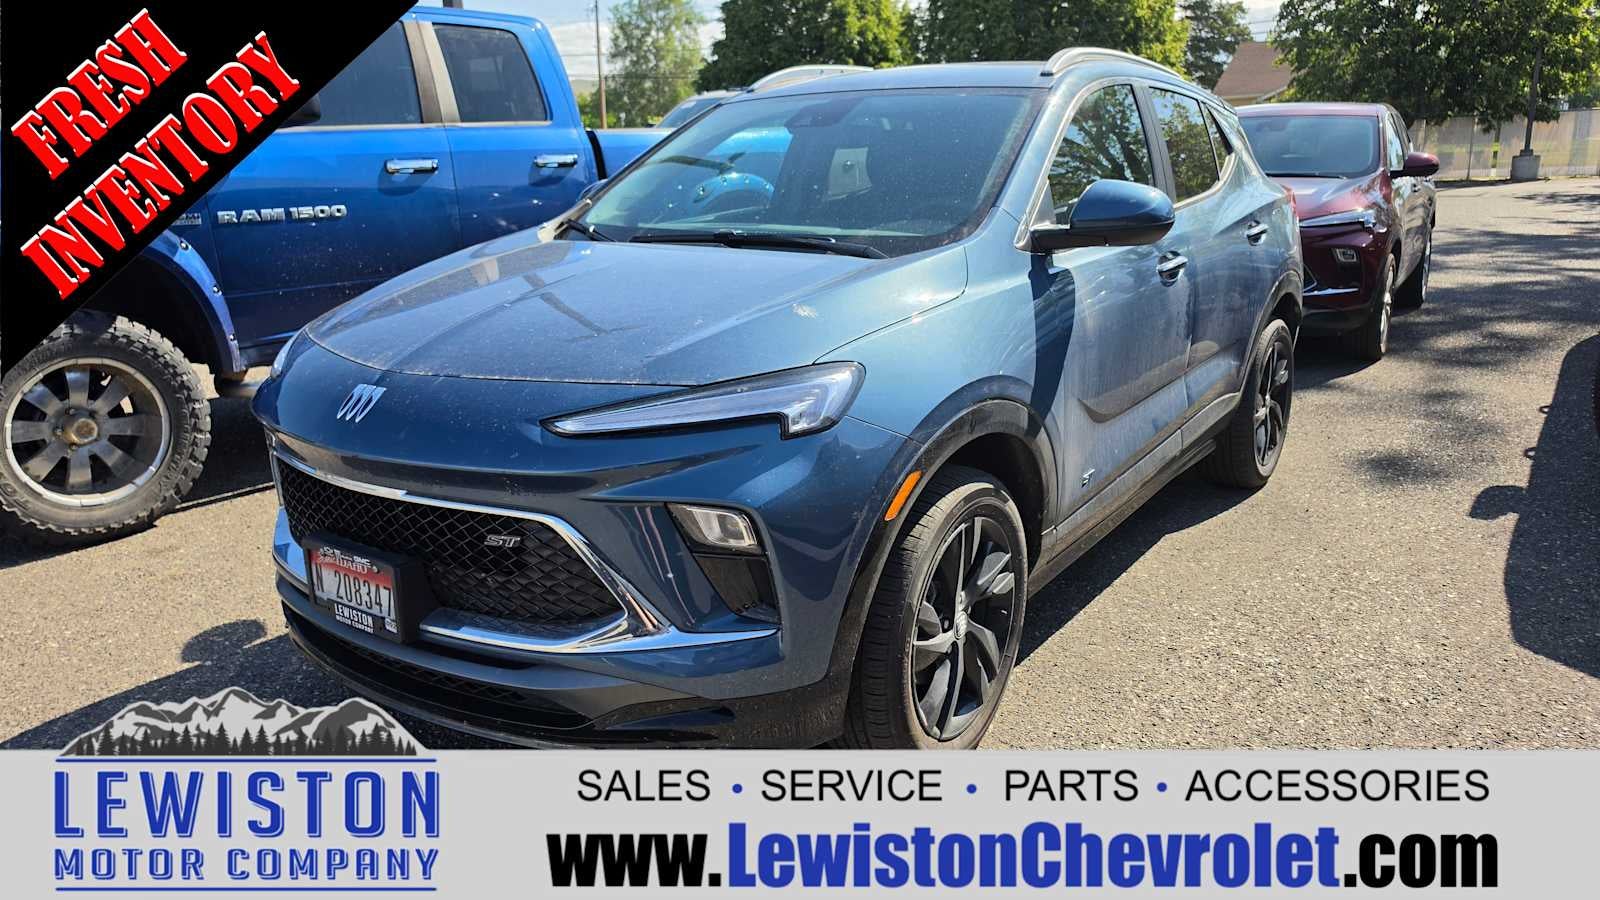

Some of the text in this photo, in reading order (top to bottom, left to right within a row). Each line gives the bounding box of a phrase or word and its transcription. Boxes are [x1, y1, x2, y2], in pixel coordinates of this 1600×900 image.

[217, 207, 286, 224] RAM
[289, 204, 347, 219] 1500
[484, 534, 521, 548] ST
[336, 559, 368, 575] IDAHO
[334, 569, 392, 618] 208347
[334, 602, 374, 628] LEWISTON
